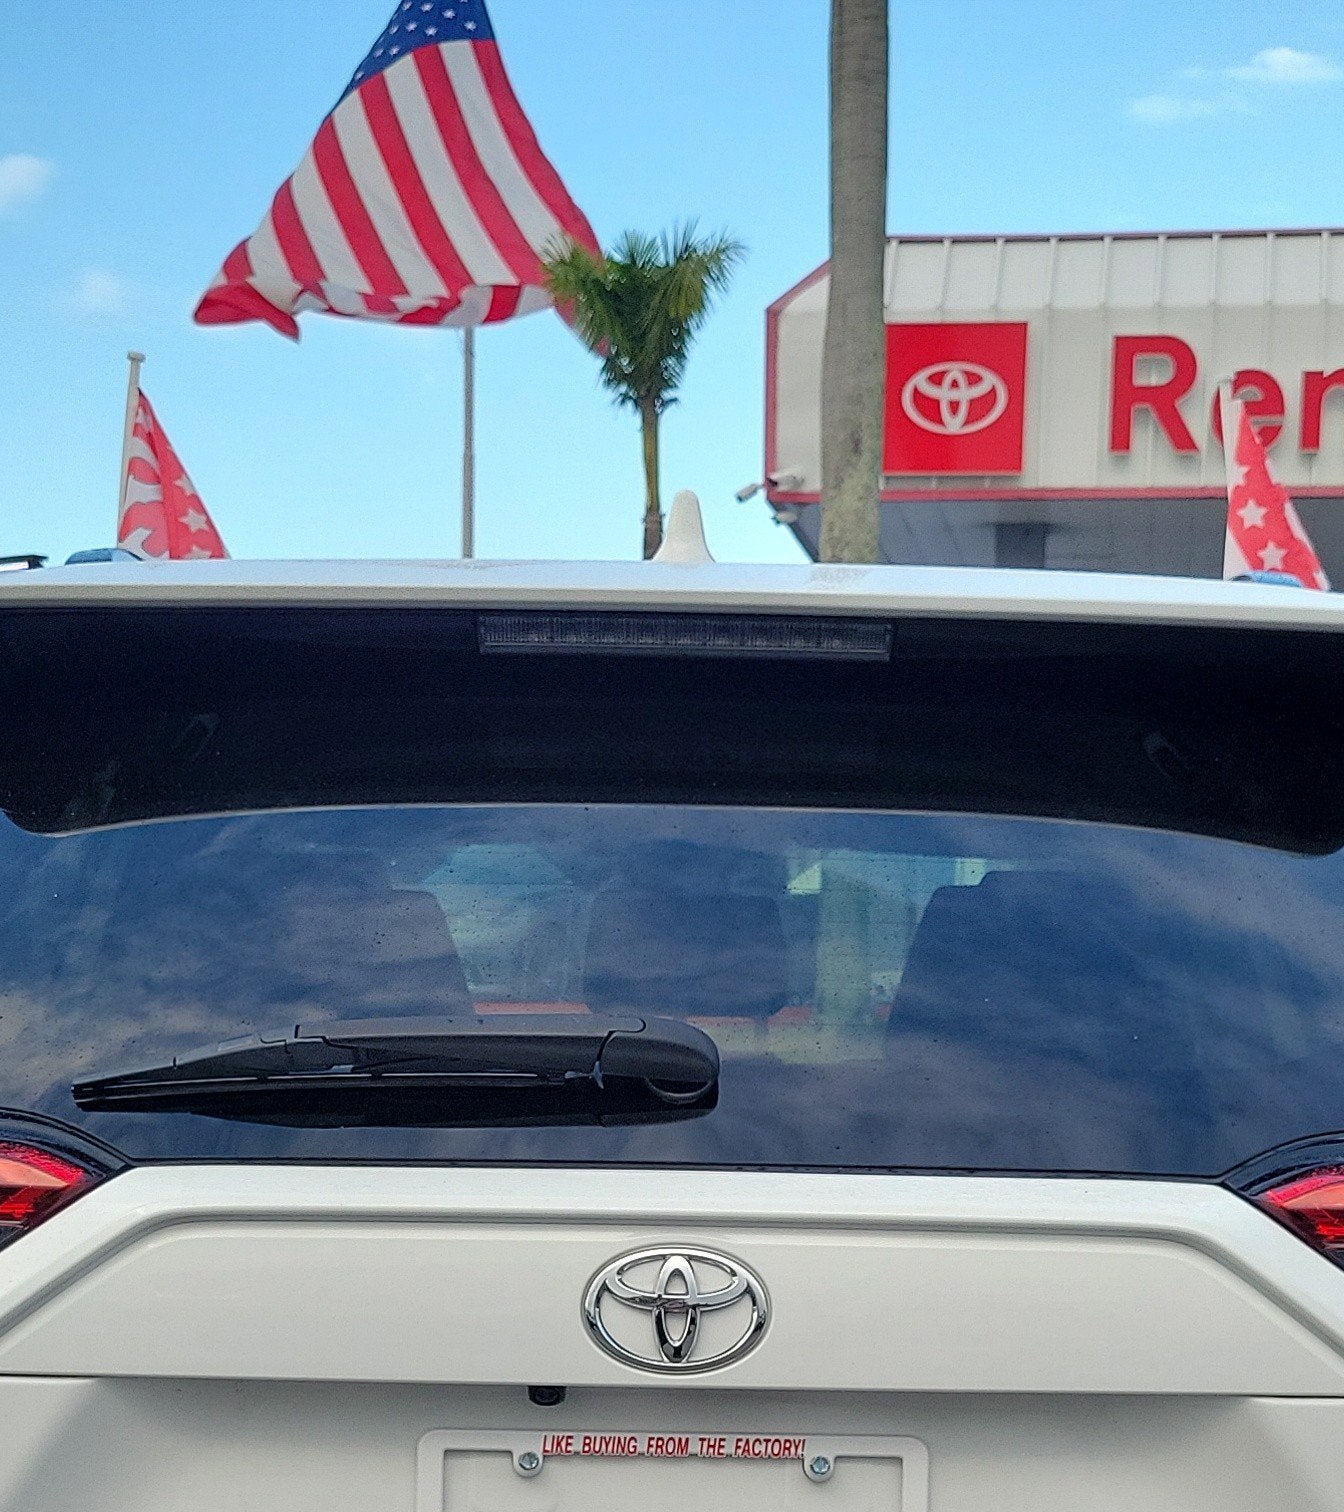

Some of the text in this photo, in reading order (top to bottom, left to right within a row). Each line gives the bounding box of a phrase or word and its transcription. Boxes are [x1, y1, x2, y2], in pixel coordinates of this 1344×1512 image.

[542, 1435, 806, 1459] LIKE BUYING FROM THE FACTORY!
